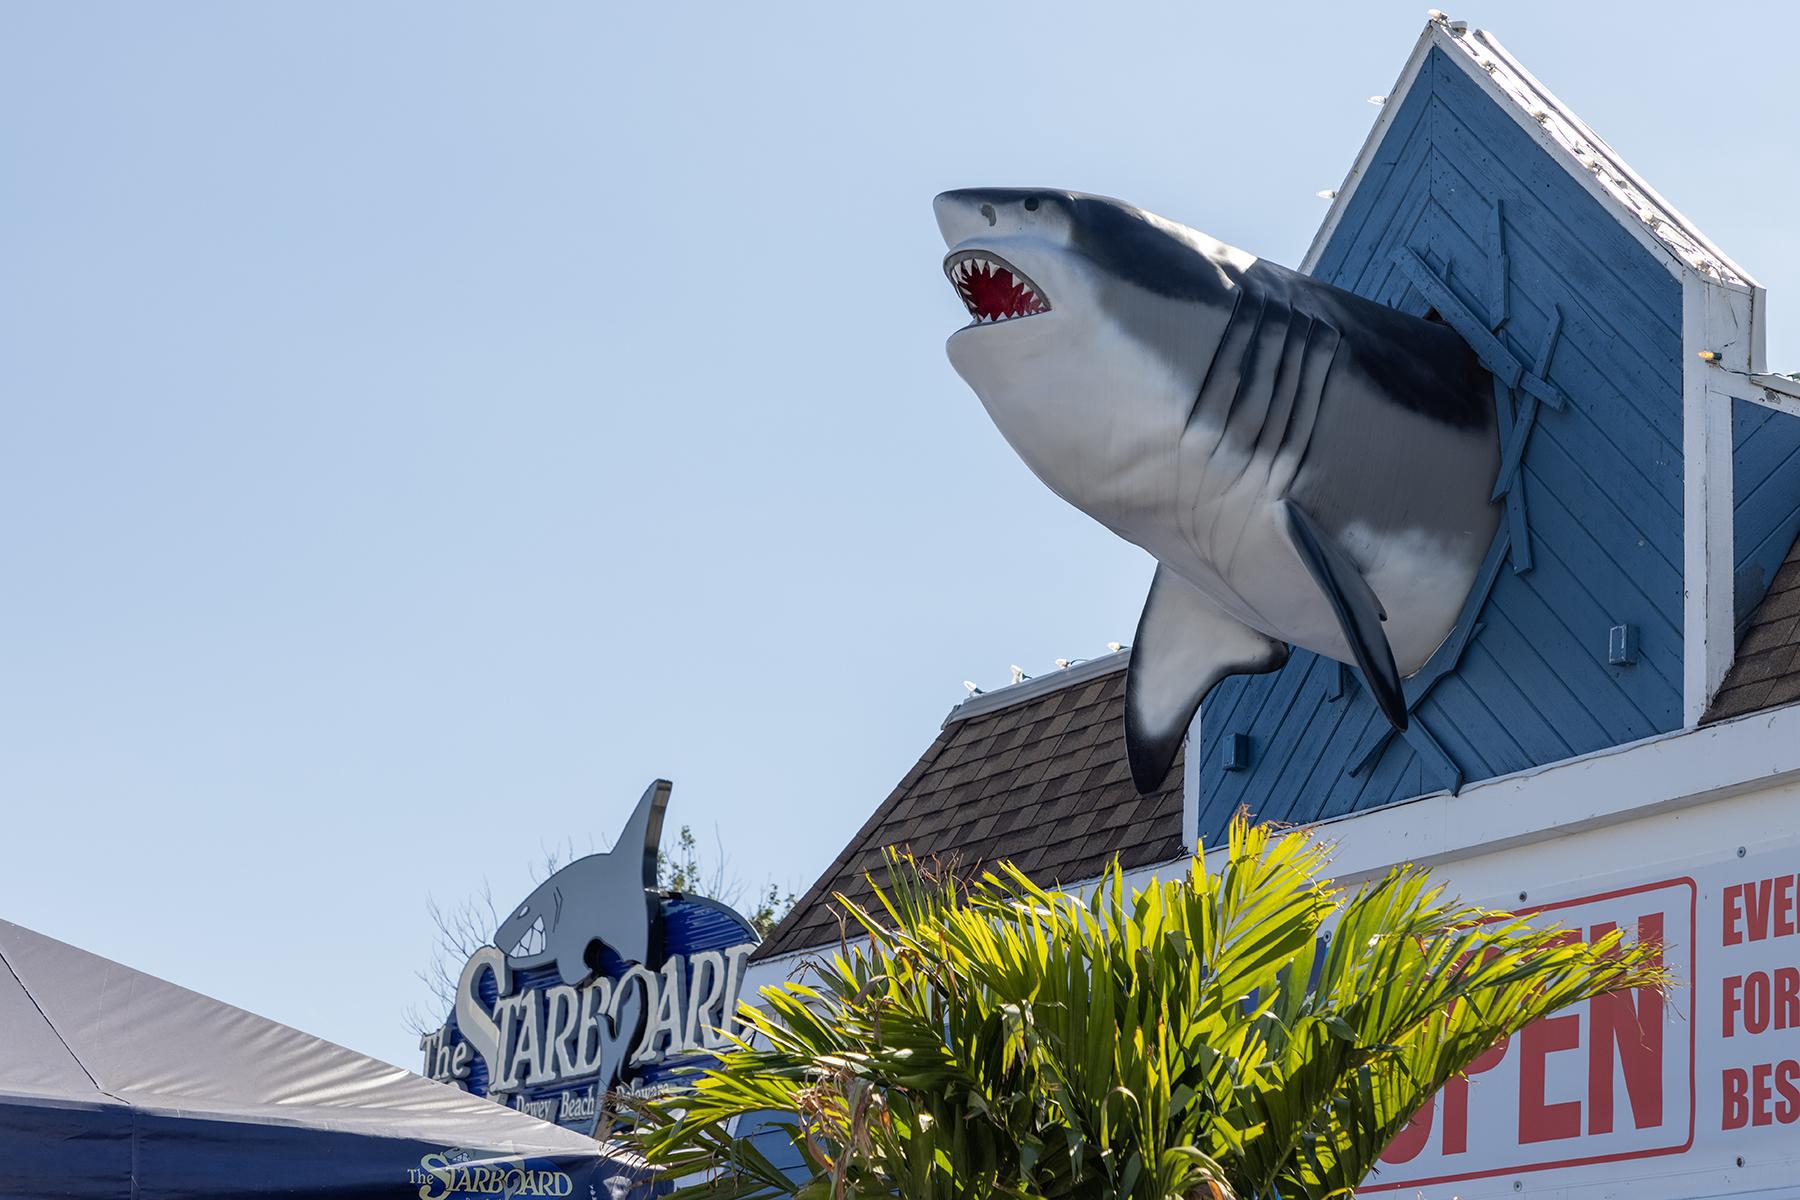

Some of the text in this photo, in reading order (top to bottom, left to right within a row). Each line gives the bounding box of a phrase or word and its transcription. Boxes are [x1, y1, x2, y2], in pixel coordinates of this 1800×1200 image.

[1723, 873, 1800, 947] EVE
[1376, 911, 1664, 1165] PEN
[1722, 967, 1800, 1038] FOR
[421, 1025, 468, 1080] The
[560, 1086, 595, 1118] Beach
[1721, 1059, 1800, 1131] BES
[407, 1152, 574, 1200] The STARBOARD
